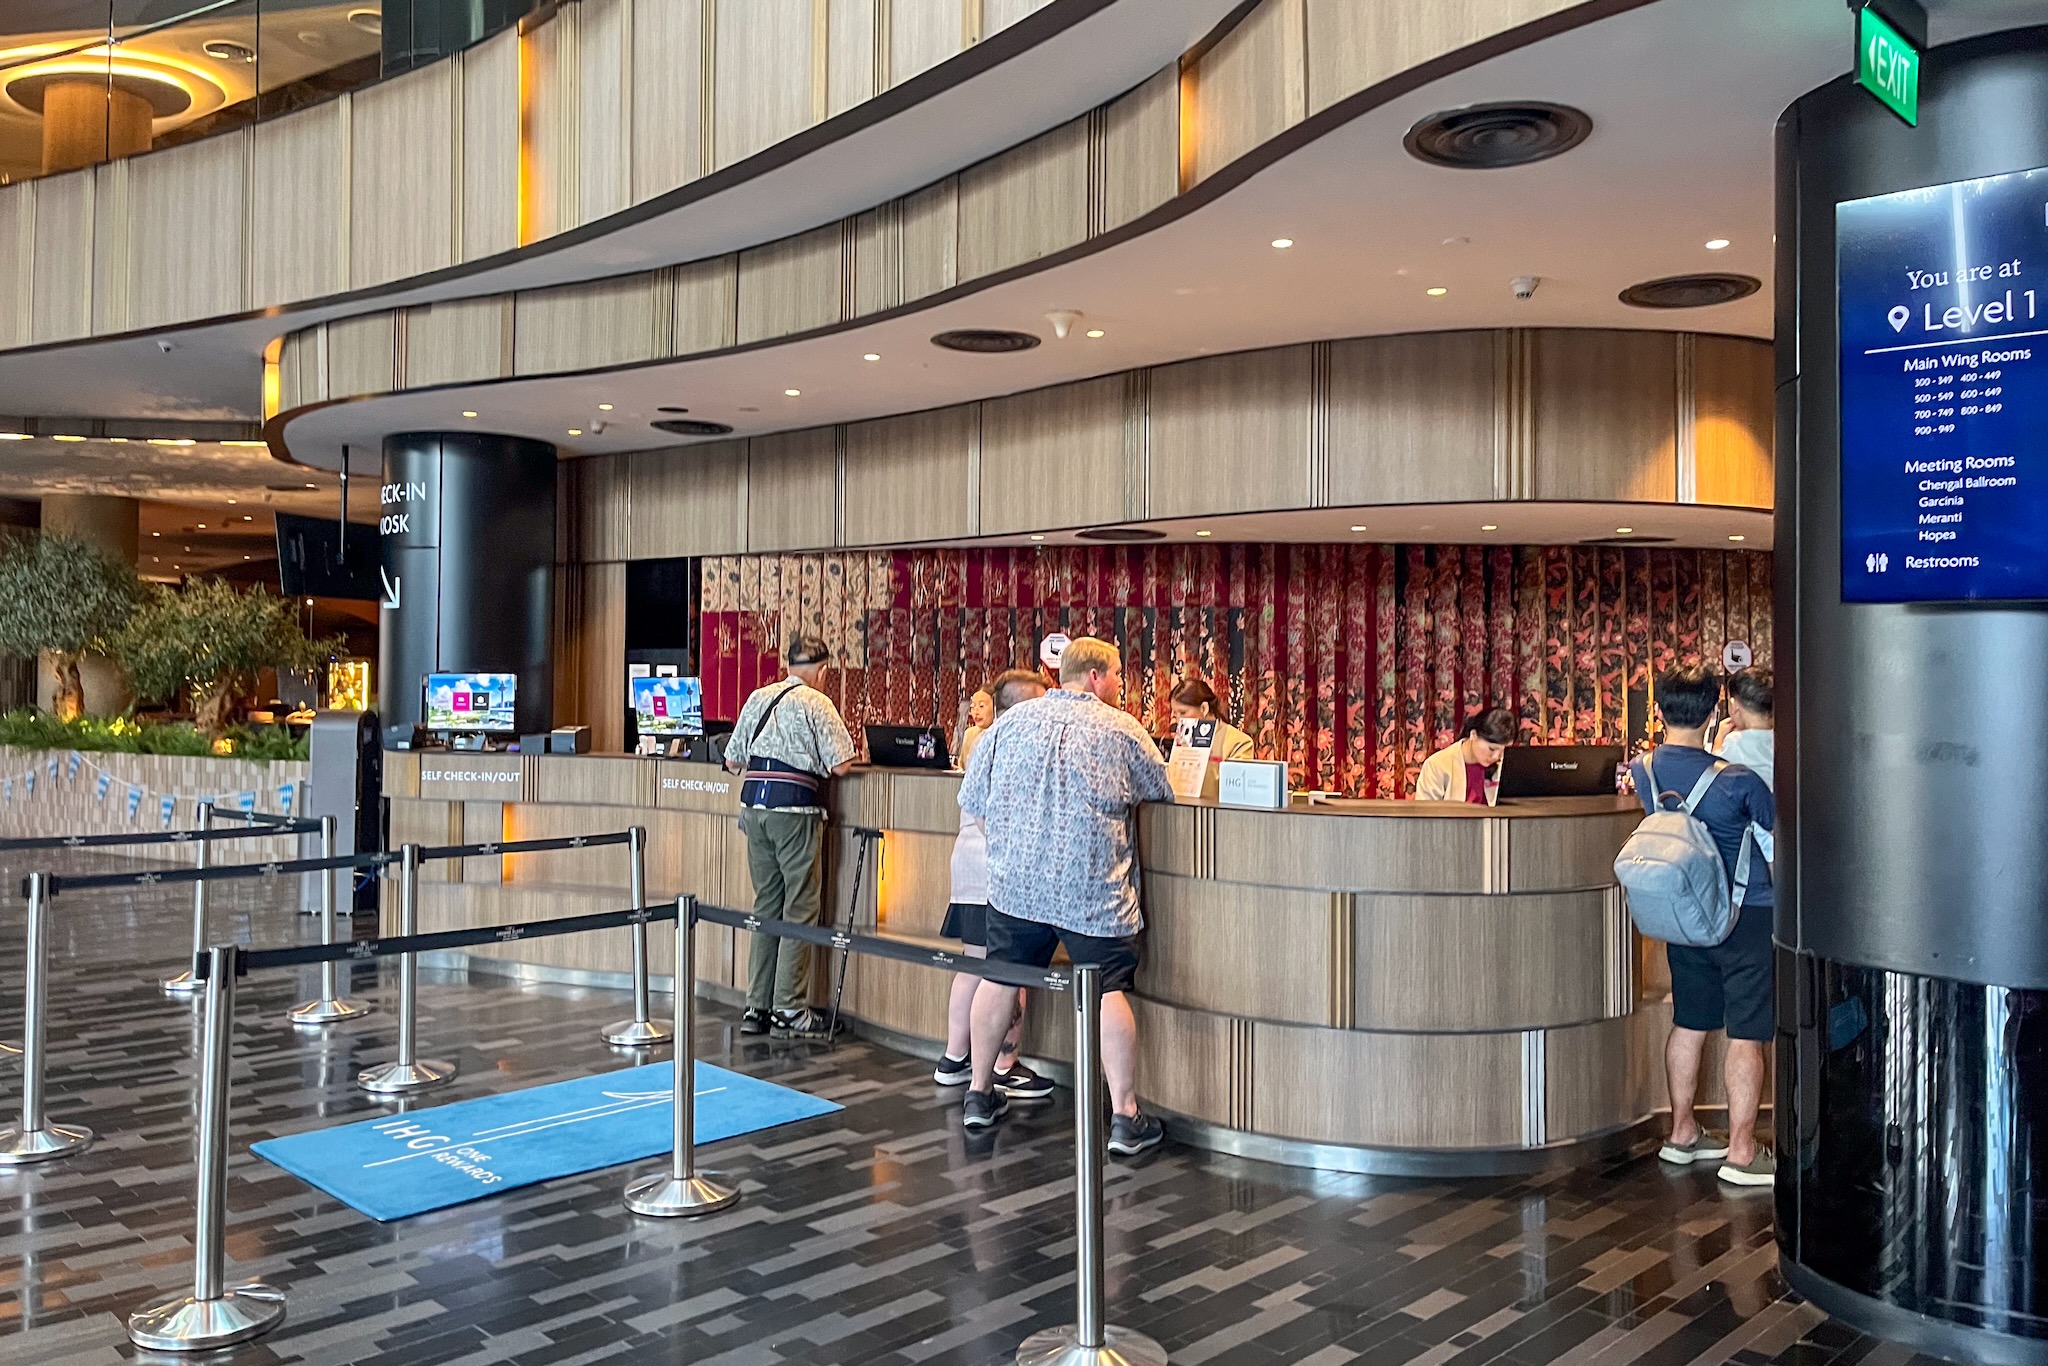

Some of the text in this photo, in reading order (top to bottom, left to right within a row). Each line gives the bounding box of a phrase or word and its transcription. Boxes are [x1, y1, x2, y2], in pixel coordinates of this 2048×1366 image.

[1878, 37, 1910, 104] EXIT
[1907, 259, 2021, 289] You are at
[1925, 289, 2034, 331] Level 1
[1904, 349, 2031, 372] Main Wing Rooms
[1905, 457, 2015, 473] Meeting Rooms
[1919, 476, 2016, 492] Chengal Ballroom
[381, 481, 425, 505] ECK-IN
[1919, 496, 1964, 508] Garcinia
[380, 513, 411, 535] IOSK
[1919, 512, 1962, 524] Meranti
[1919, 531, 1957, 543] Hopea
[1906, 556, 1979, 568] Restrooms
[422, 771, 520, 783] SELF CHECK-IN/OUT
[1225, 777, 1241, 788] IHG
[663, 779, 729, 794] SELF CHECK-IN/OUT
[371, 1119, 451, 1150] IHG
[431, 1151, 502, 1183] REWARDS
